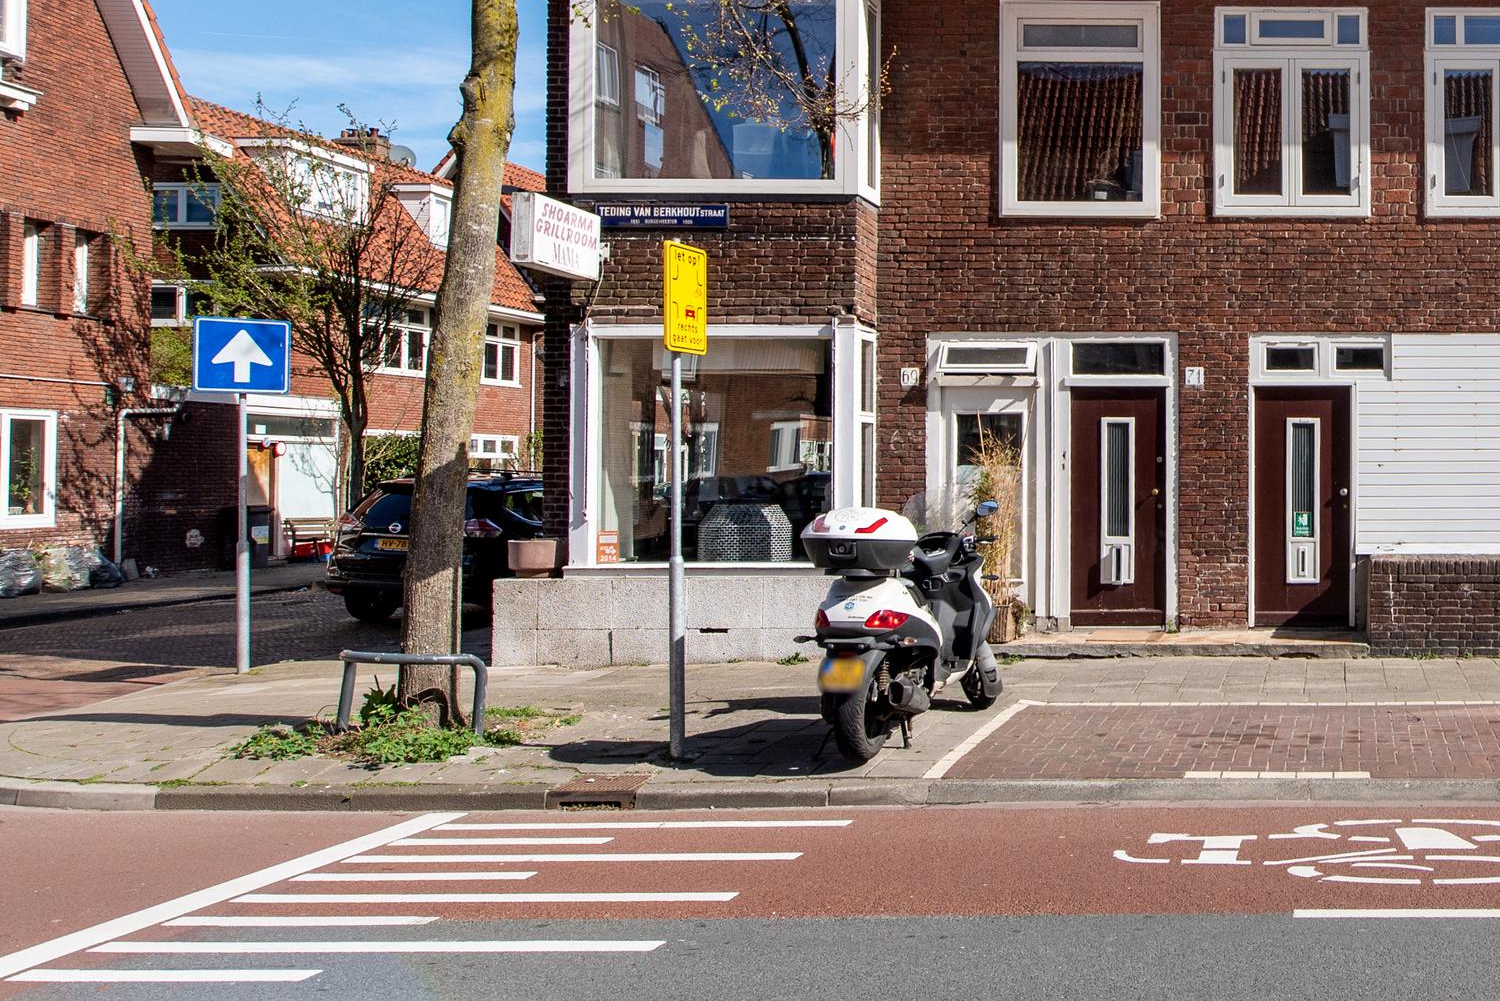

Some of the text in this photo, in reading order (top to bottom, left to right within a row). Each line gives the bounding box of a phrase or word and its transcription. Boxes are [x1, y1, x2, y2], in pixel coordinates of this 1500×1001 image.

[542, 203, 593, 233] SHOARMA
[599, 206, 631, 217] TEDING
[634, 206, 651, 217] VAN
[536, 218, 597, 250] GRILLROOM
[677, 322, 698, 334] rechts
[903, 369, 918, 384] 69
[1187, 369, 1201, 384] 71
[381, 540, 408, 548] HV-78
